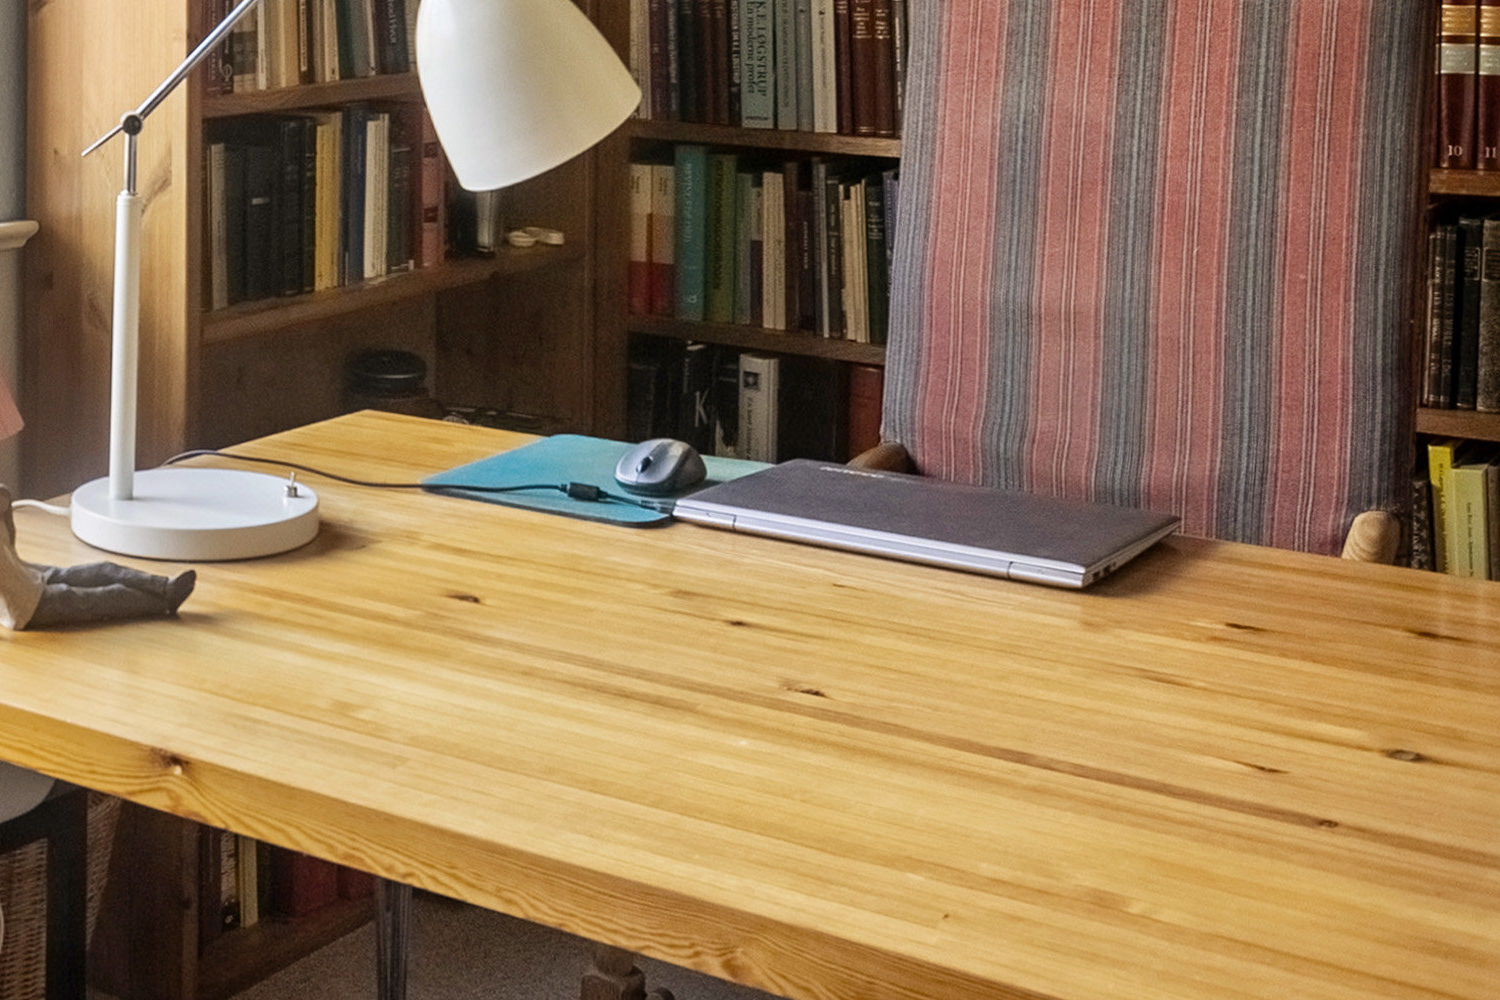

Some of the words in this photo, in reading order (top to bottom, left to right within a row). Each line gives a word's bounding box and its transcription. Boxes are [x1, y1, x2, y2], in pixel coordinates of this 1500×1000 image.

[746, 16, 756, 60] moderne
[756, 27, 768, 97] LØGSTRUP
[745, 63, 758, 95] profet
[1447, 145, 1463, 157] 10
[1485, 146, 1498, 159] 11
